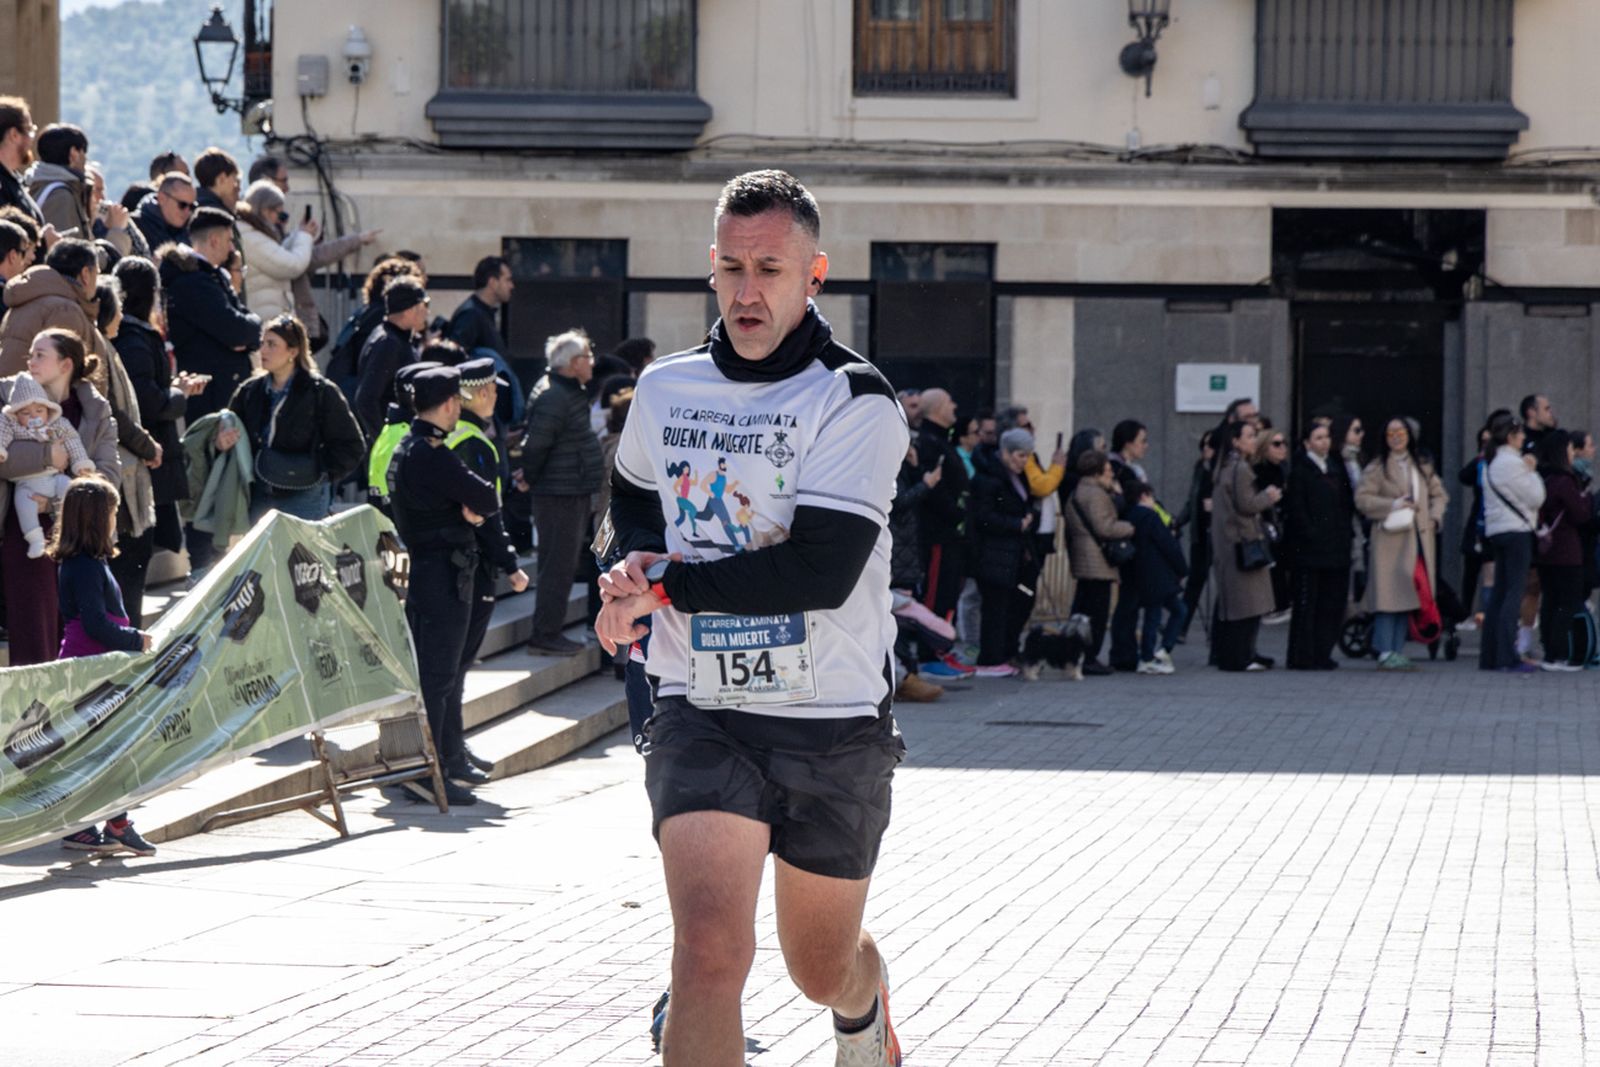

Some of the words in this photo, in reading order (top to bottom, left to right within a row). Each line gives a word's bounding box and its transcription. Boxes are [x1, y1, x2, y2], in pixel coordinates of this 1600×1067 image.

[669, 406, 681, 419] VI
[682, 408, 735, 426] CARRERA
[738, 414, 797, 428] CAMINATA
[663, 427, 707, 449] BUENA
[711, 433, 764, 454] MUERTE
[708, 619, 741, 628] CARRERA
[743, 614, 791, 627] CAMINATA
[701, 632, 727, 647] BUENA
[728, 630, 771, 647] MUERTE
[716, 650, 776, 686] 154
[238, 674, 281, 707] VERDAD
